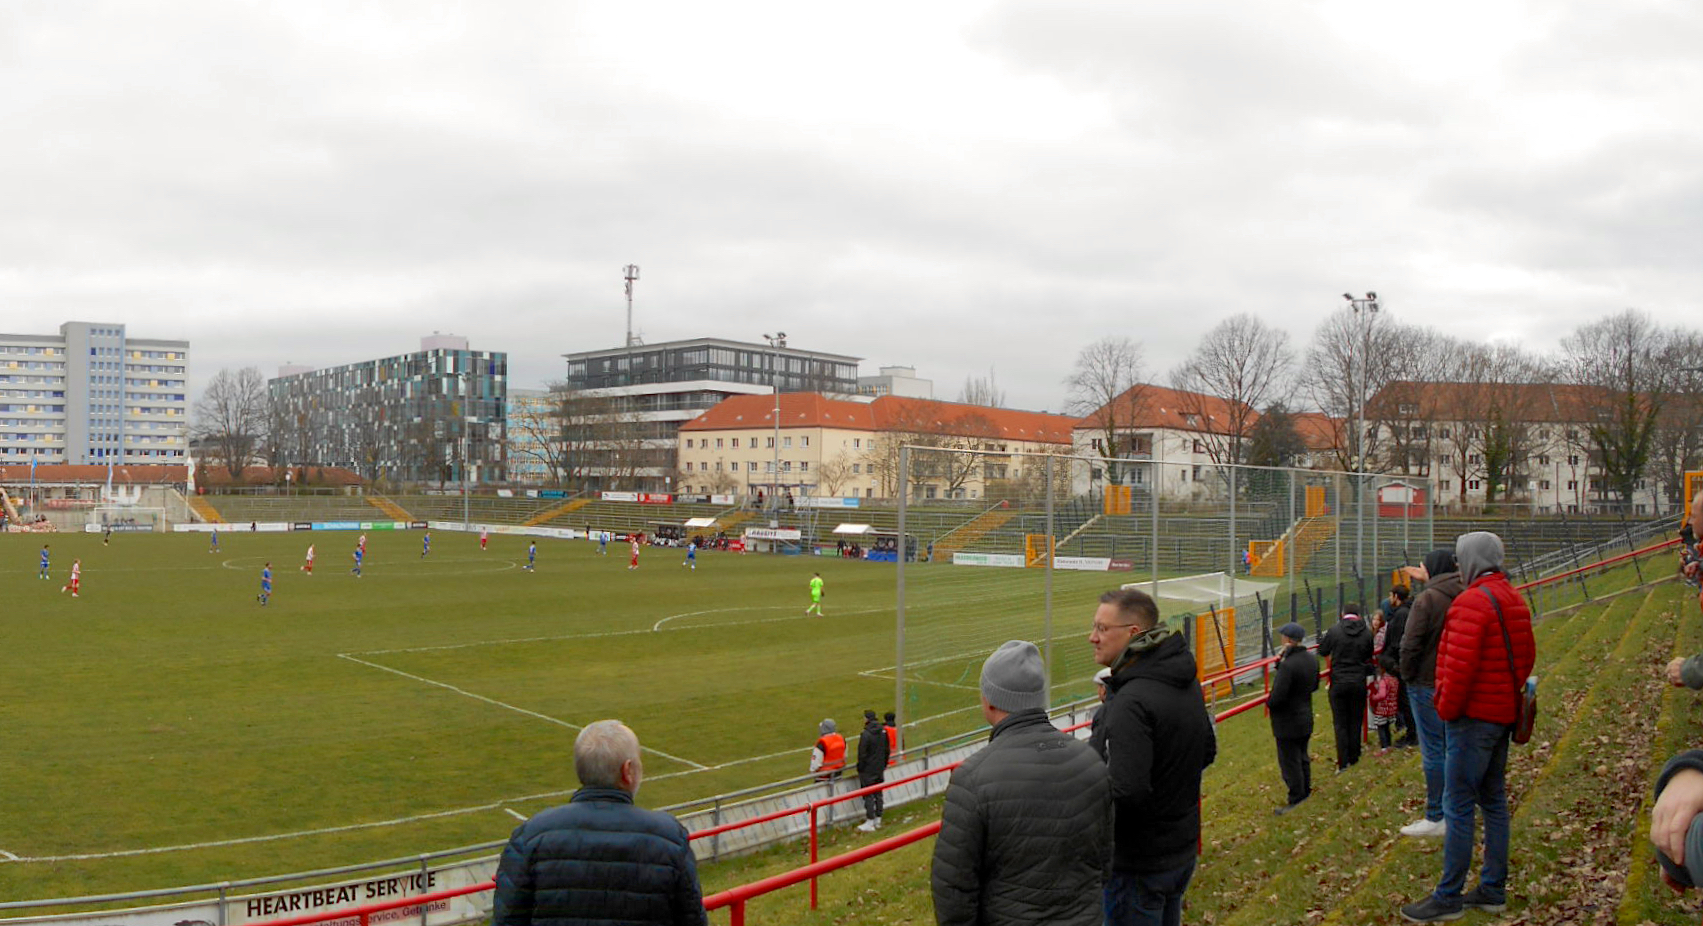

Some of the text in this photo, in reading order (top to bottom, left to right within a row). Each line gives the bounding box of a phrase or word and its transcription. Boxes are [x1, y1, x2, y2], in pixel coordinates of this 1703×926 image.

[247, 871, 436, 917] HEARTBEAT SERVICE
[402, 901, 447, 917] Getrnke
